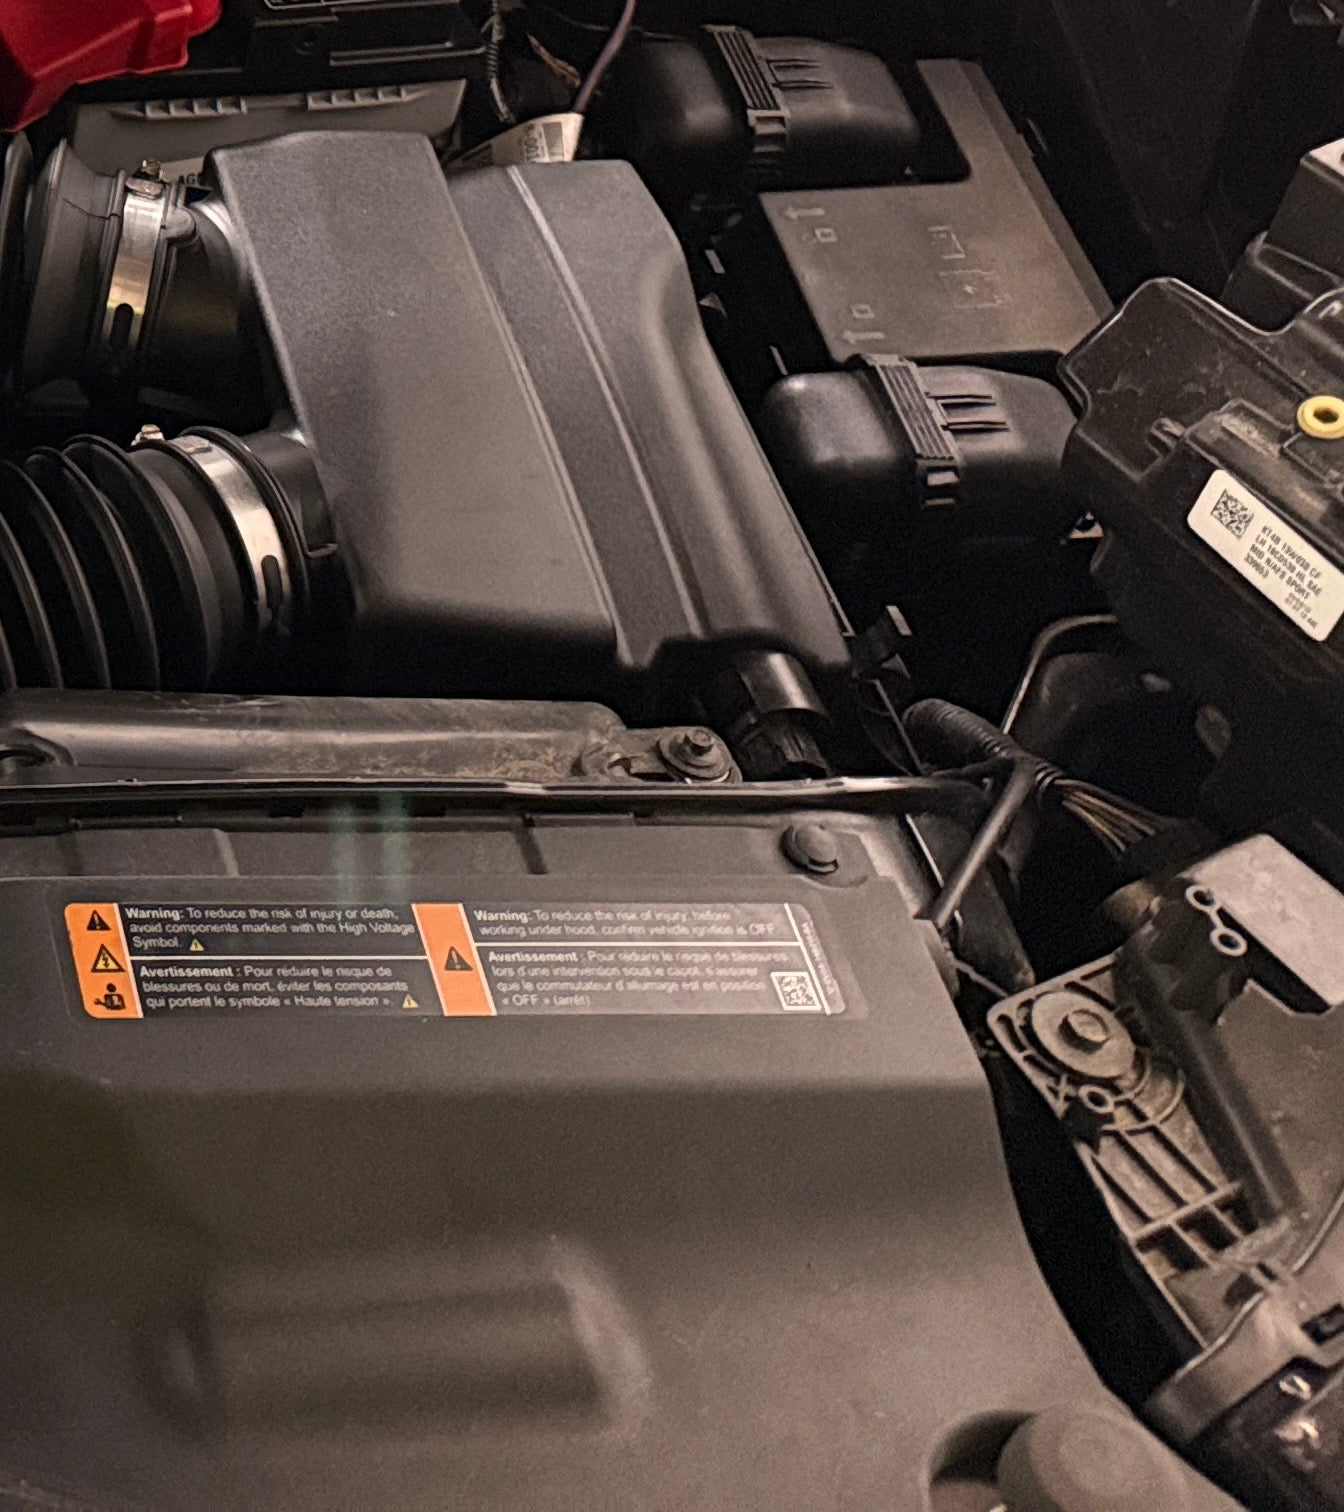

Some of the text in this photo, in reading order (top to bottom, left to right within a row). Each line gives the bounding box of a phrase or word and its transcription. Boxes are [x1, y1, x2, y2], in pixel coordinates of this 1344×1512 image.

[1286, 575, 1310, 600] SPORT
[125, 908, 399, 921] Warning: To reduce the risk of injury or death,
[474, 910, 531, 923] Warning:
[533, 909, 549, 921] To
[552, 909, 592, 921] reduce
[593, 909, 614, 921] the
[130, 922, 415, 936] avoid components marked with the High Voltage
[480, 924, 526, 937] working
[528, 924, 561, 935] under
[489, 951, 579, 962] Avertissement
[587, 950, 615, 961] Pour
[140, 966, 233, 977] Avertissement
[244, 965, 272, 977] Pour
[277, 965, 319, 977] réduire
[321, 966, 333, 977] le
[336, 967, 373, 979] risque
[376, 966, 392, 977] de
[142, 981, 202, 992] blessures
[204, 982, 221, 992] ou
[224, 981, 240, 992] de
[313, 980, 332, 991] les
[334, 981, 409, 993] composants
[496, 982, 520, 992] que
[522, 980, 534, 991] le
[146, 996, 166, 1008] qui
[168, 996, 212, 1008] portent
[214, 995, 226, 1007] le
[229, 995, 280, 1008] symbole
[294, 995, 332, 1006] Haute
[334, 995, 379, 1006] tension
[512, 994, 538, 1006] OFF
